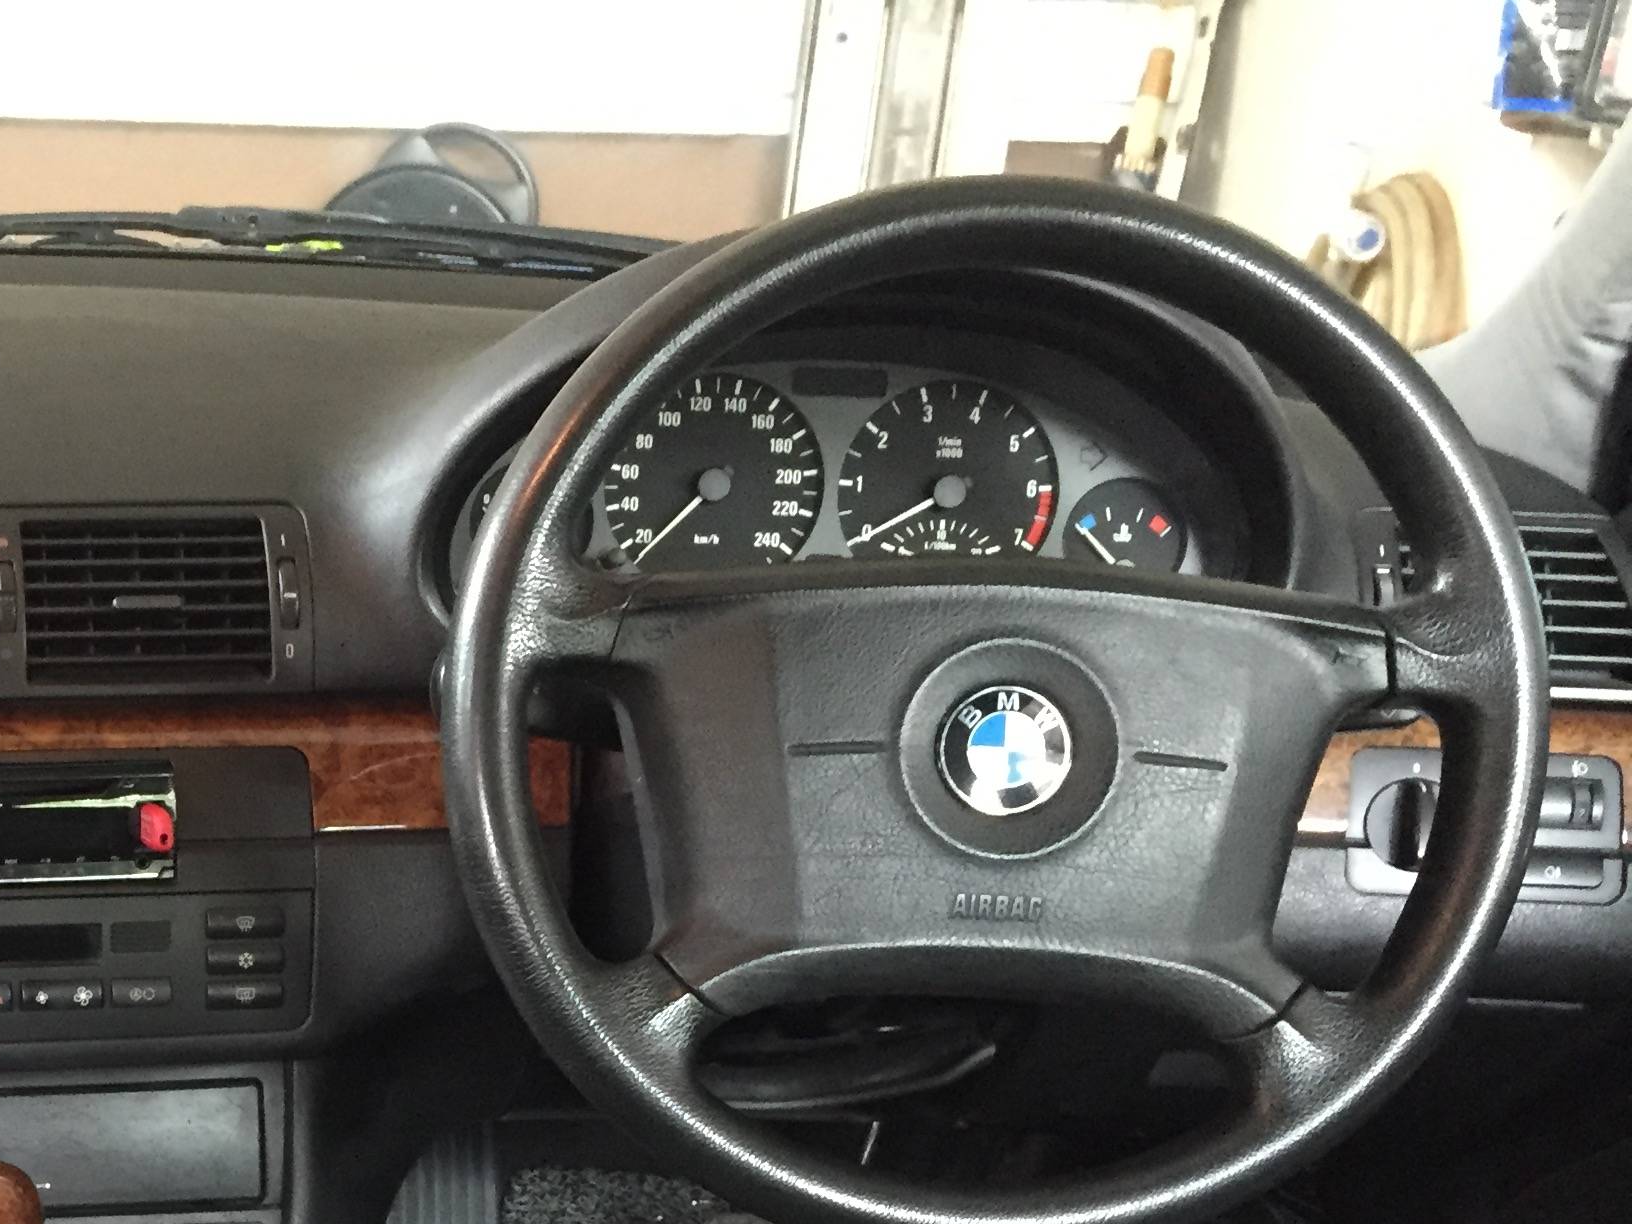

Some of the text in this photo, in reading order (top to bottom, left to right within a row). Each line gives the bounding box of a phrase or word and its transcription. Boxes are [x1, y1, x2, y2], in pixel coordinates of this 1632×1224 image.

[690, 396, 712, 412] 120
[724, 397, 747, 413] 140
[658, 411, 681, 427] 100
[751, 414, 775, 430] 160
[922, 404, 934, 424] 3
[968, 406, 981, 425] 4
[635, 433, 654, 450] 80
[770, 437, 793, 454] 180
[877, 430, 889, 449] 2
[1009, 434, 1020, 453] 5
[621, 464, 640, 480] 60
[775, 468, 802, 485] 200
[856, 475, 863, 493] 1
[1026, 479, 1037, 498] 6
[620, 496, 640, 512] 40
[772, 500, 799, 517] 220
[634, 528, 653, 544] 20
[693, 534, 719, 545] km/h
[754, 532, 780, 548] 240
[1014, 528, 1024, 545] 7
[957, 691, 1060, 734] BMW
[950, 893, 1042, 921] AIRBAG
